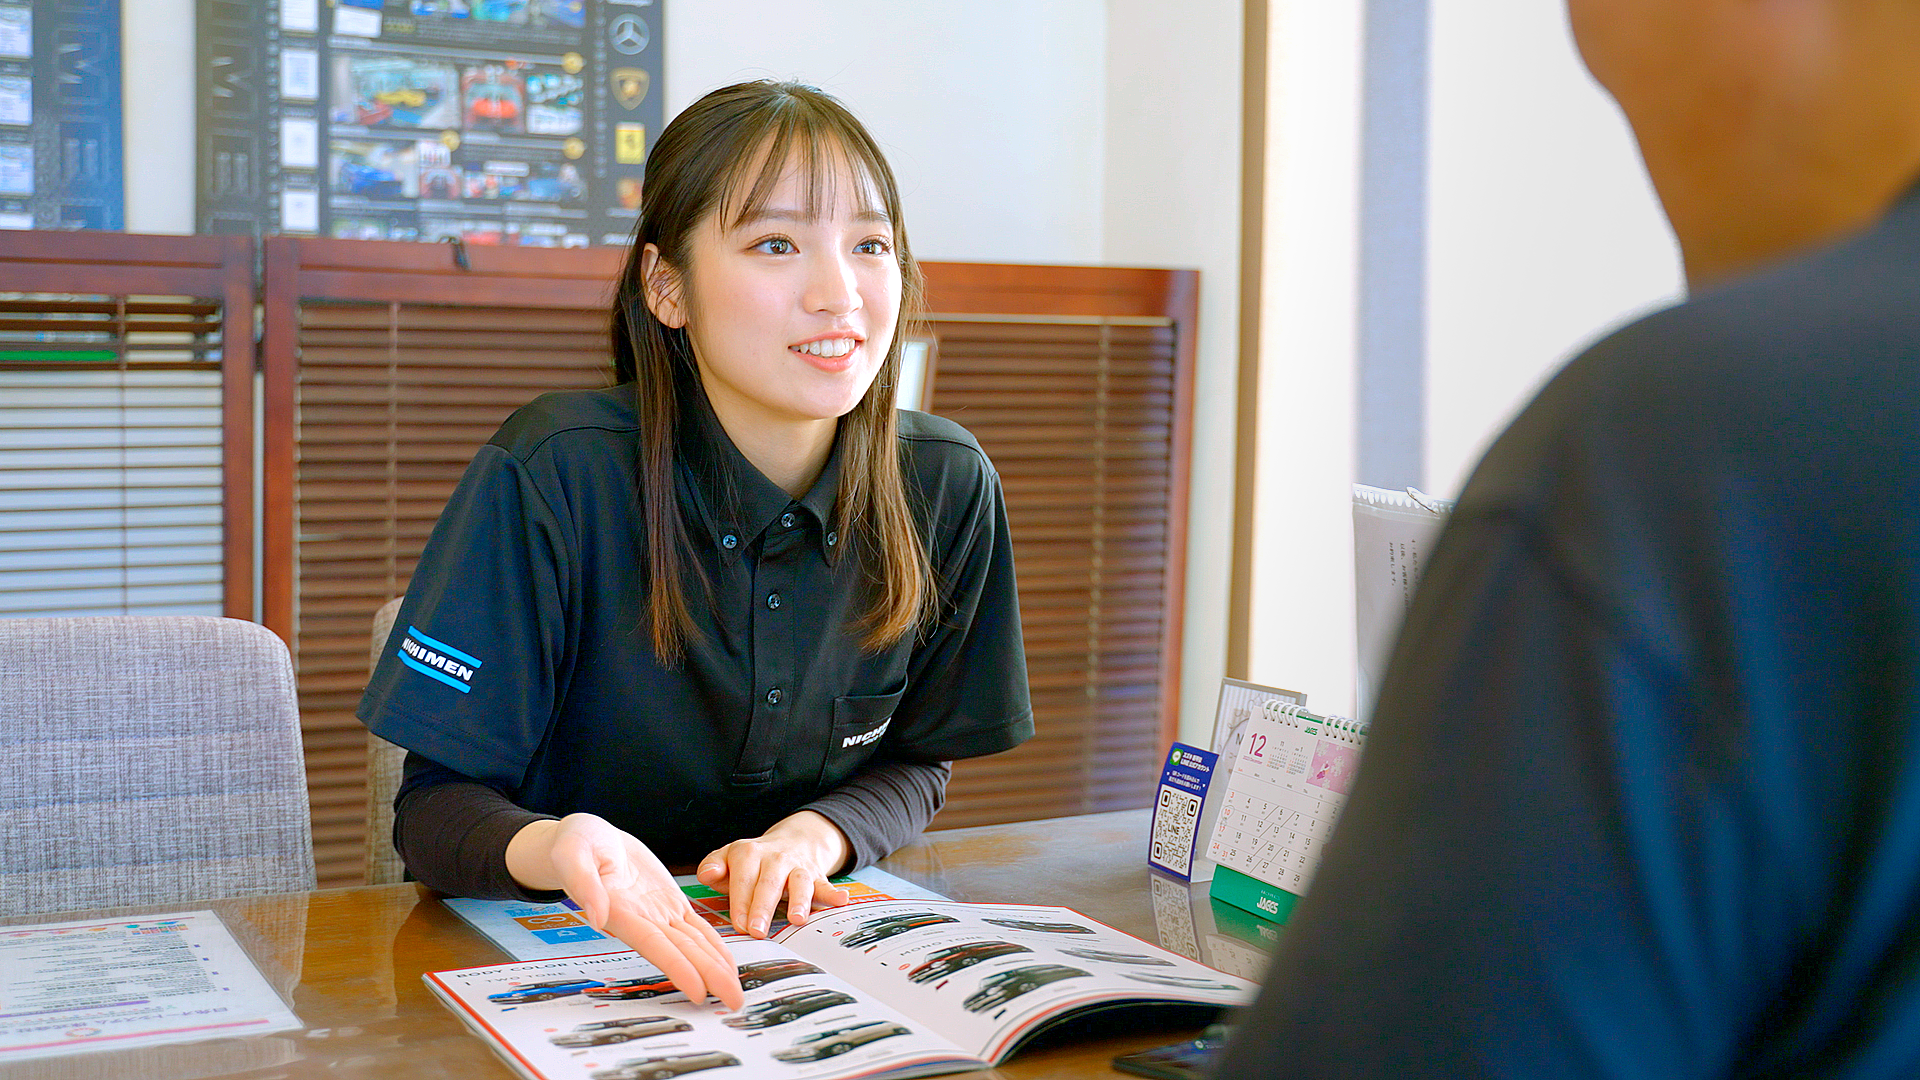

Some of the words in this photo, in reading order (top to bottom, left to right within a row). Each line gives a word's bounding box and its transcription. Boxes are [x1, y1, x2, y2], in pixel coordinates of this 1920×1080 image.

[401, 637, 474, 682] NICHIMEN
[1248, 732, 1267, 758] 12
[1168, 824, 1180, 835] LINE
[1294, 874, 1300, 882] 29
[1257, 897, 1279, 914] JACCS
[833, 912, 875, 925] THREE
[900, 941, 942, 956] MONO
[456, 969, 502, 978] BODY
[510, 962, 568, 972] COLOR
[574, 956, 632, 966] LINEUP
